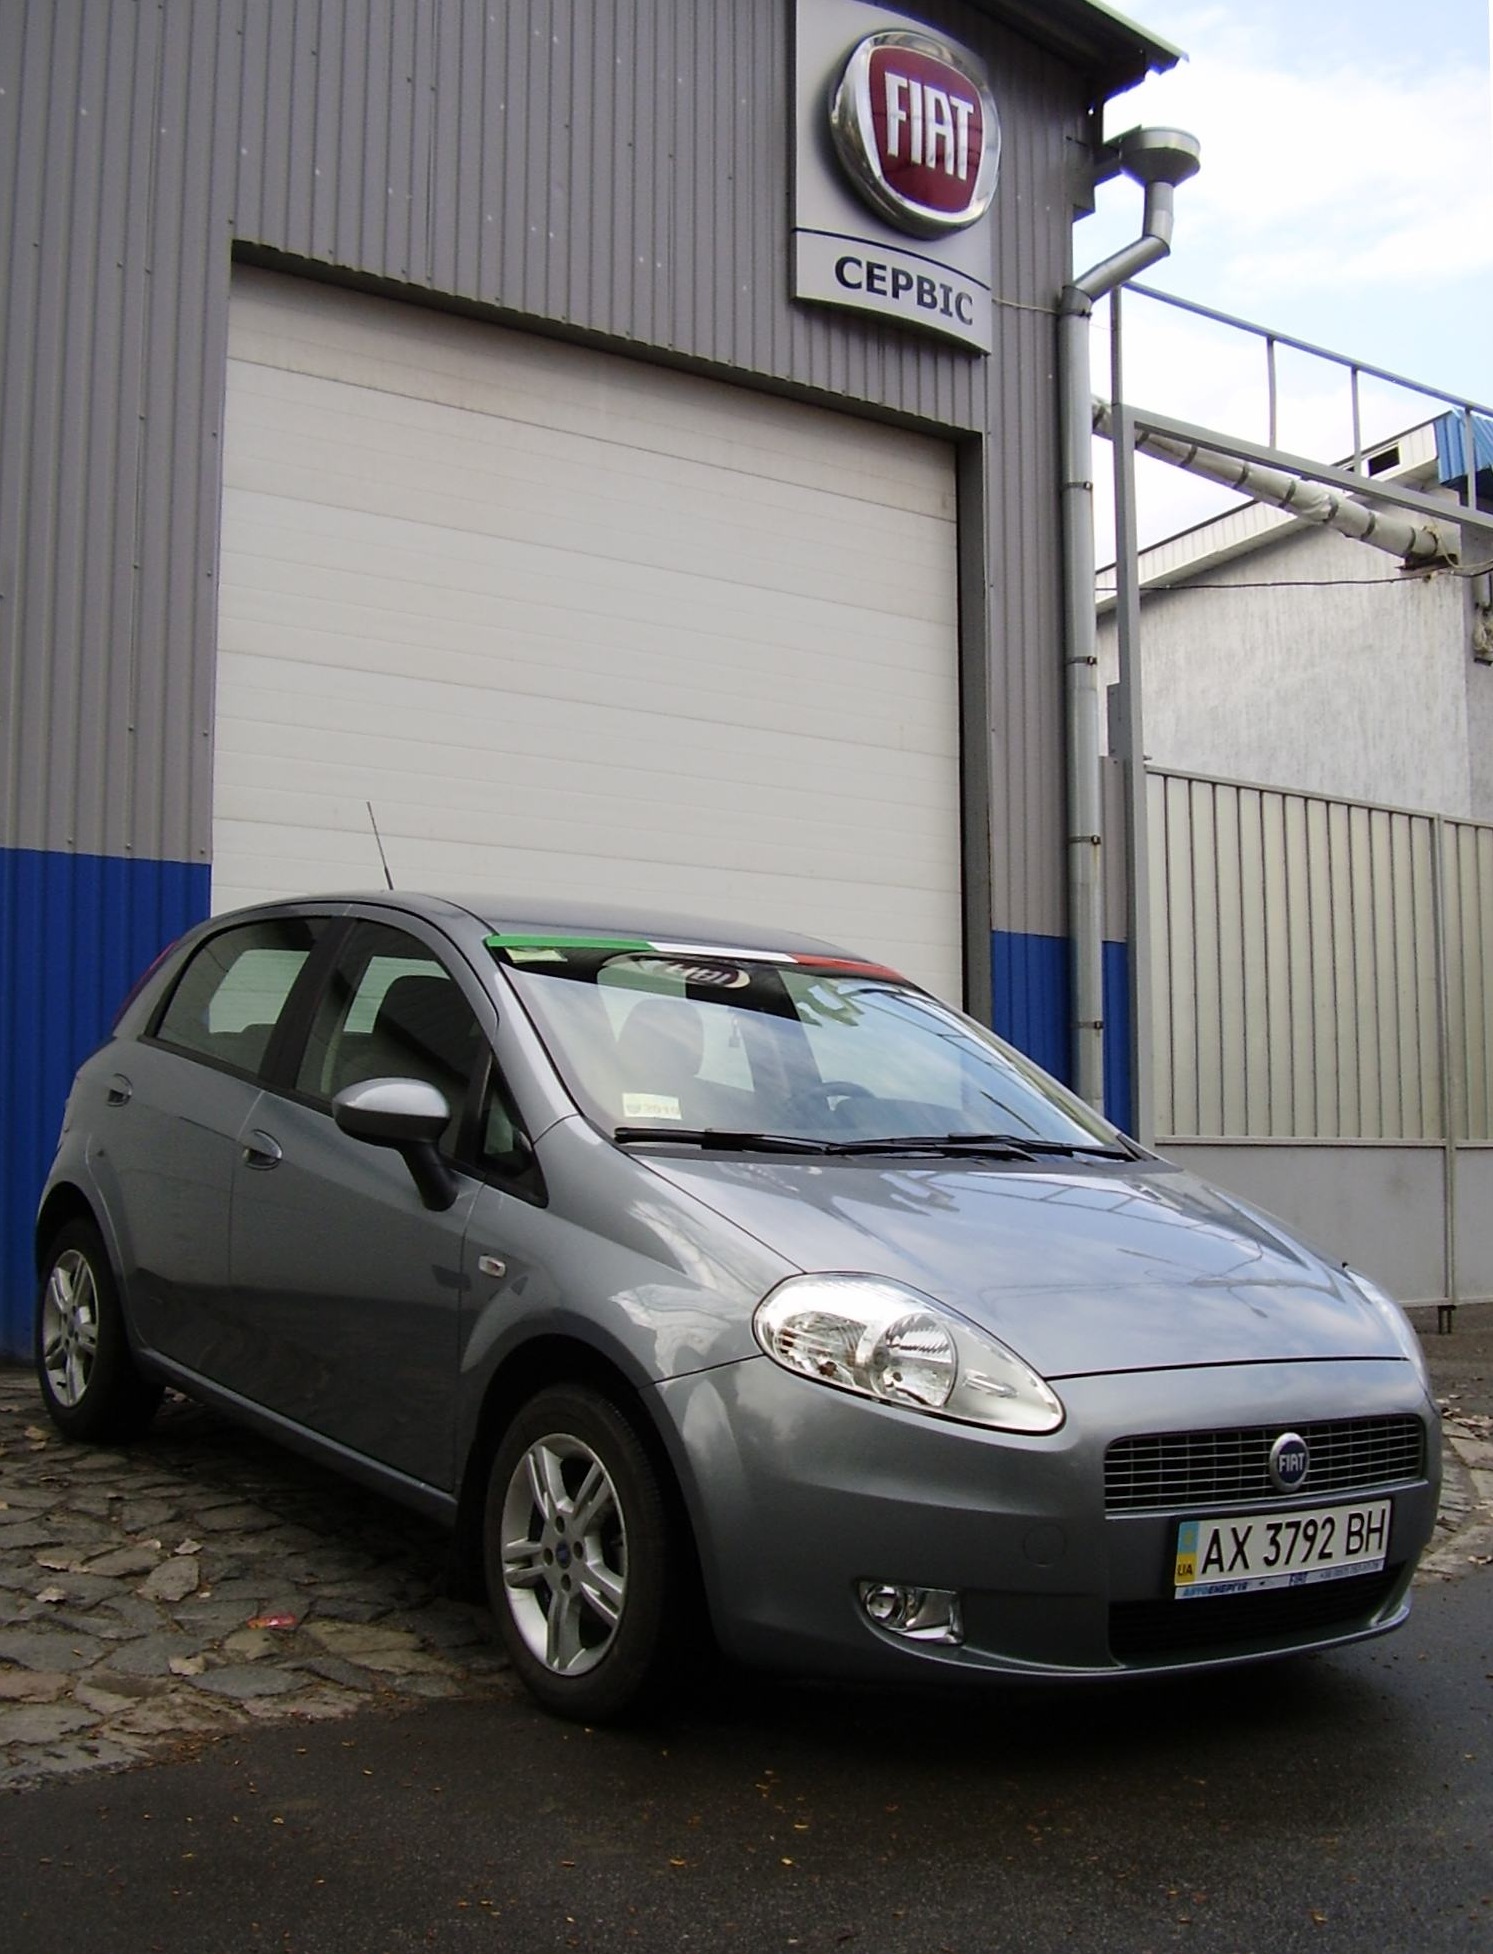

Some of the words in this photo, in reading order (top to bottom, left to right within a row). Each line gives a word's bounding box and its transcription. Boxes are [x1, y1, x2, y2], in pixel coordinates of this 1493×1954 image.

[884, 71, 974, 181] FIAT
[834, 256, 973, 326] СЕРВІС
[1279, 1453, 1305, 1472] FIAT
[1177, 1563, 1193, 1576] UA
[1201, 1525, 1253, 1574] AX
[1263, 1516, 1336, 1567] 3792
[1345, 1507, 1387, 1556] BH
